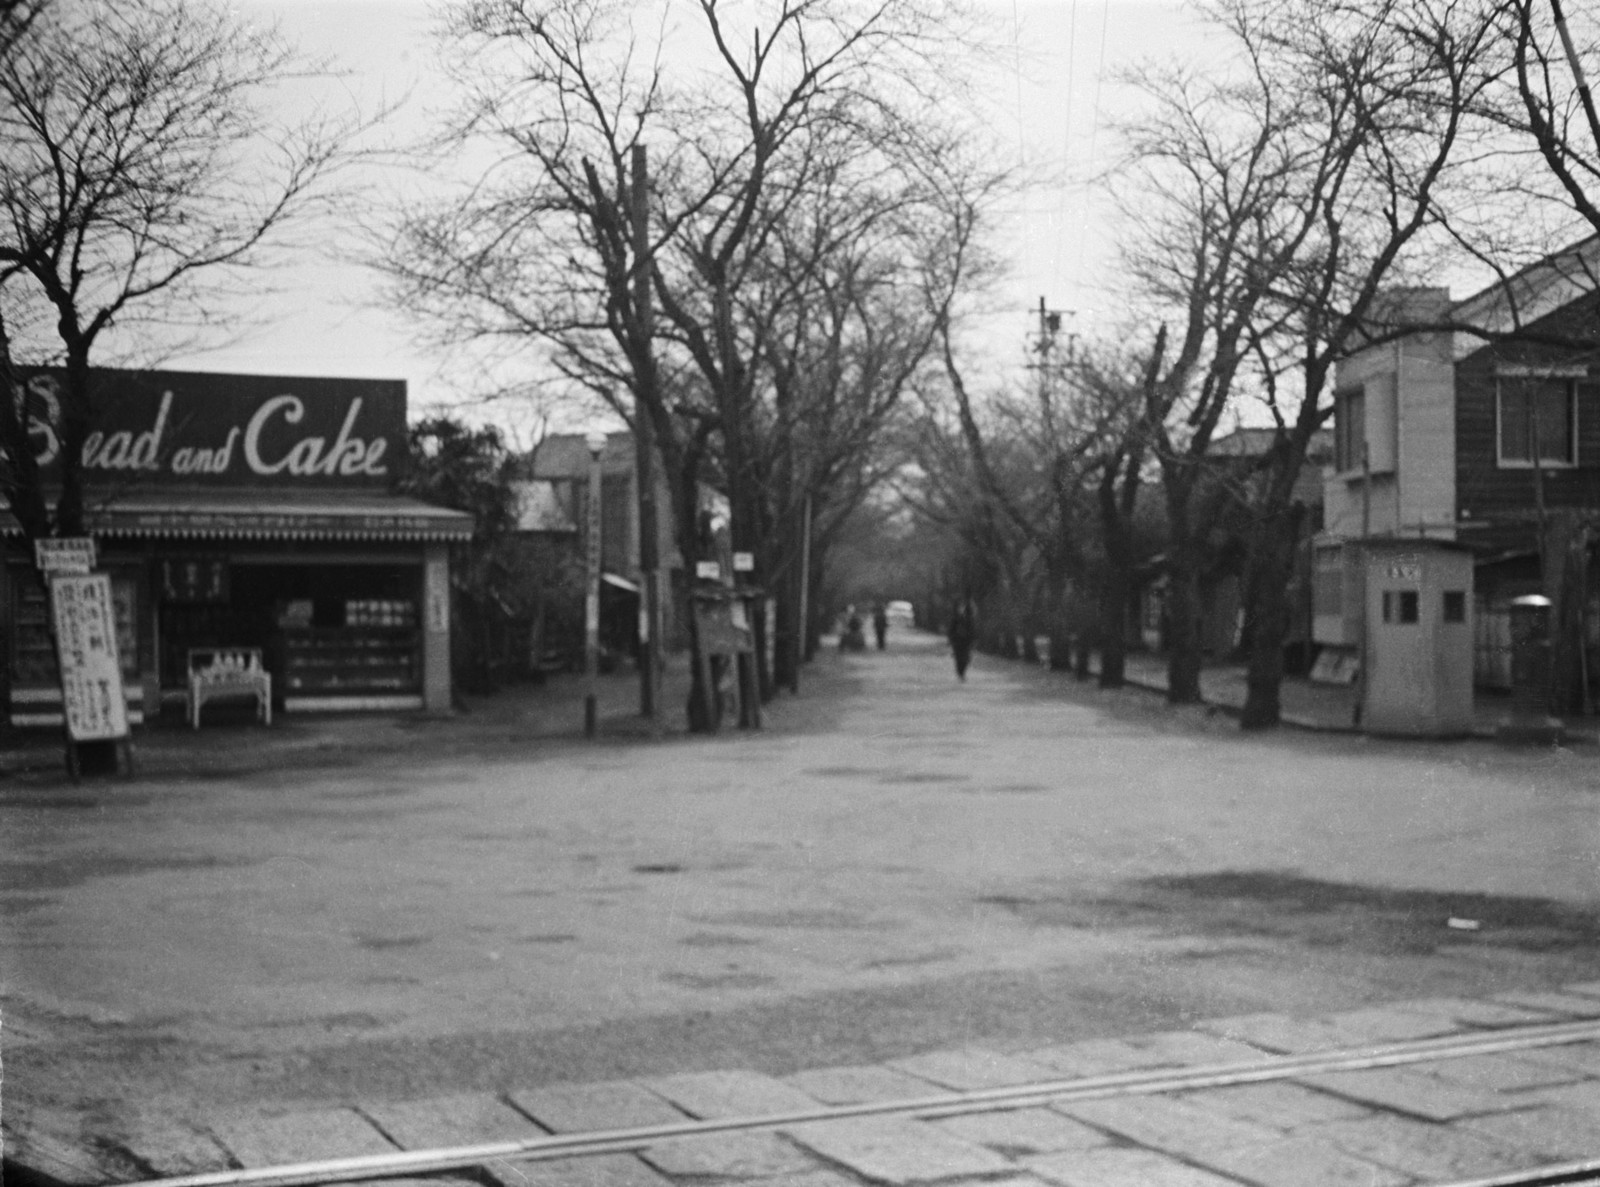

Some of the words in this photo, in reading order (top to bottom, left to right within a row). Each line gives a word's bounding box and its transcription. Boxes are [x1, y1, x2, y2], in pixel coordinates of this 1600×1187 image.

[13, 374, 173, 470] Bead
[172, 426, 240, 475] and
[244, 394, 388, 476] Cake
